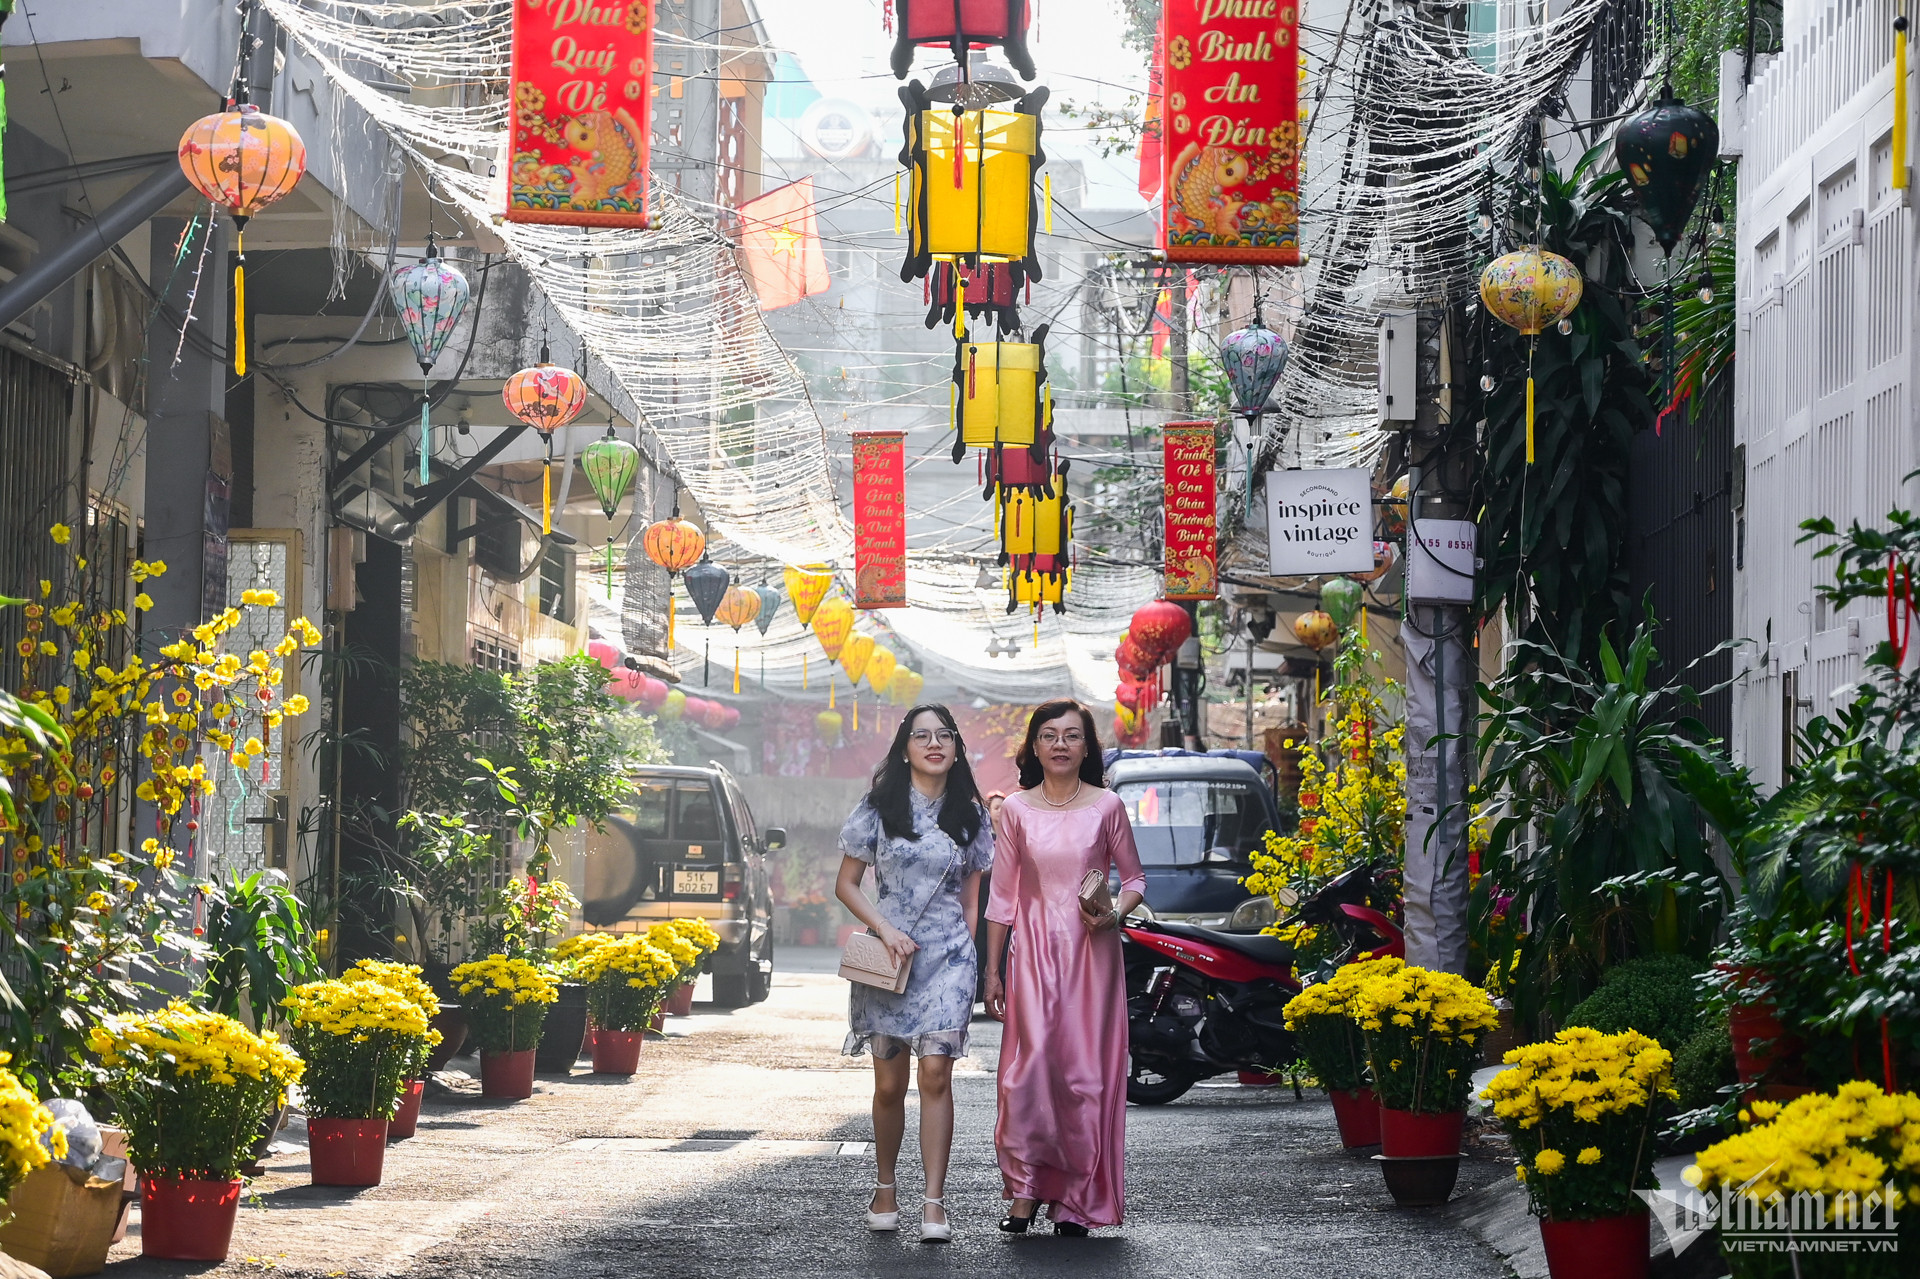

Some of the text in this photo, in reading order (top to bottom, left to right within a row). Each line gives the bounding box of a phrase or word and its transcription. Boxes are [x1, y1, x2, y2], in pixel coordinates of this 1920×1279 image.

[547, 0, 623, 31] Phú
[1199, 30, 1274, 62] Bình
[551, 36, 617, 76] Quý
[1204, 71, 1262, 103] An
[557, 80, 608, 112] Về
[1199, 114, 1267, 146] Đến
[867, 457, 891, 470] Tết
[1177, 463, 1201, 477] Về
[864, 473, 894, 486] Đến
[1177, 480, 1204, 494] Con
[1299, 484, 1339, 498] SECONDHAND
[865, 488, 892, 504] Gia
[1176, 496, 1206, 510] Cháu
[1278, 497, 1361, 522] inspirée
[866, 520, 892, 533] Vui
[1283, 524, 1359, 545] vintage
[1179, 544, 1202, 557] An
[1306, 549, 1336, 558] BOUTIQUE
[686, 872, 705, 882] 51K
